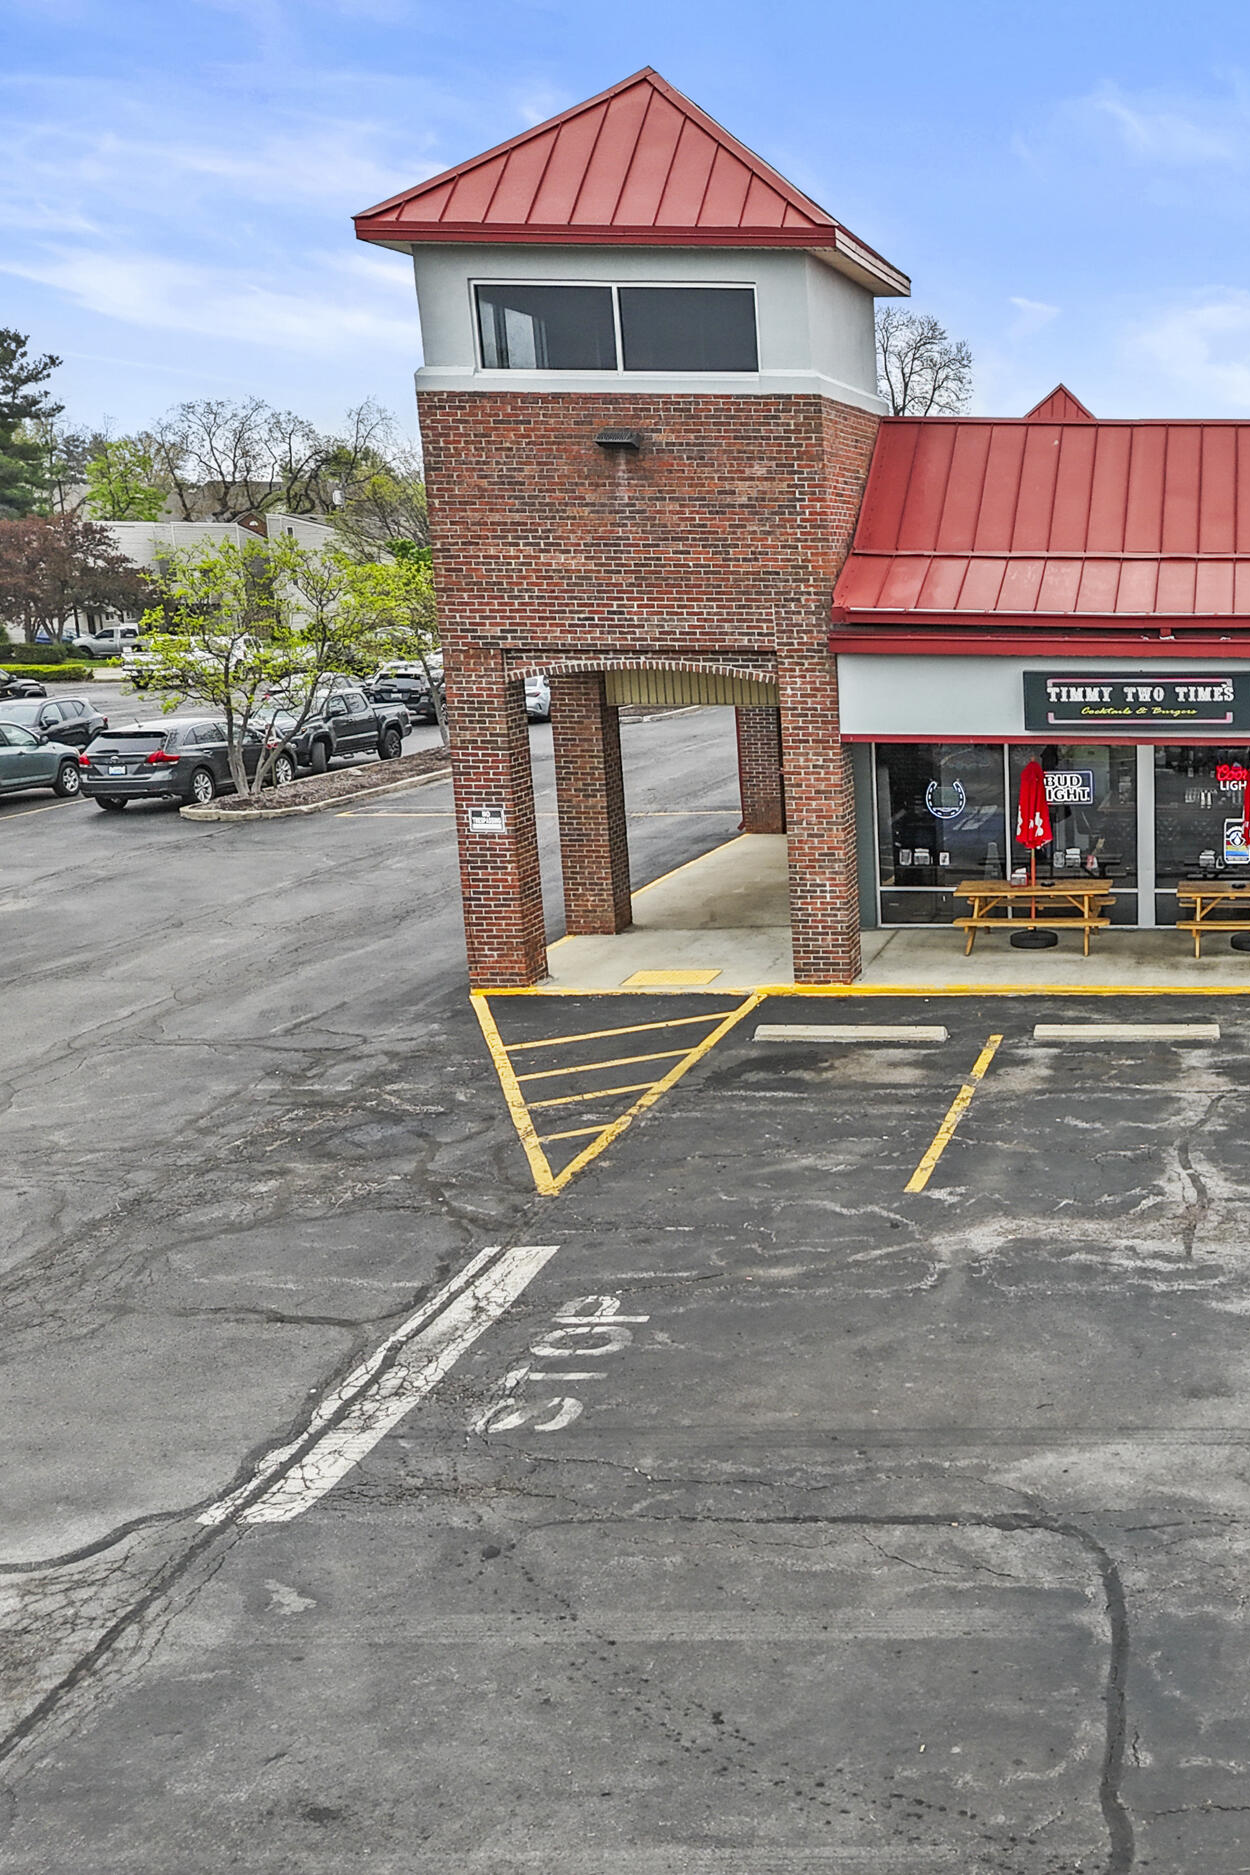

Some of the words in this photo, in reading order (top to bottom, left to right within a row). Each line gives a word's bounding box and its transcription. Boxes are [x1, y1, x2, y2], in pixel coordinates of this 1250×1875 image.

[1047, 687, 1113, 702] TIMMY
[1123, 687, 1165, 702] TWO
[1081, 706, 1133, 716] Cocktails
[1135, 706, 1148, 715] &
[1151, 706, 1198, 717] Burgers
[1216, 764, 1249, 781] Coor
[1044, 774, 1082, 788] BUD
[1220, 781, 1247, 791] LIGH
[473, 1295, 650, 1434] STOP
